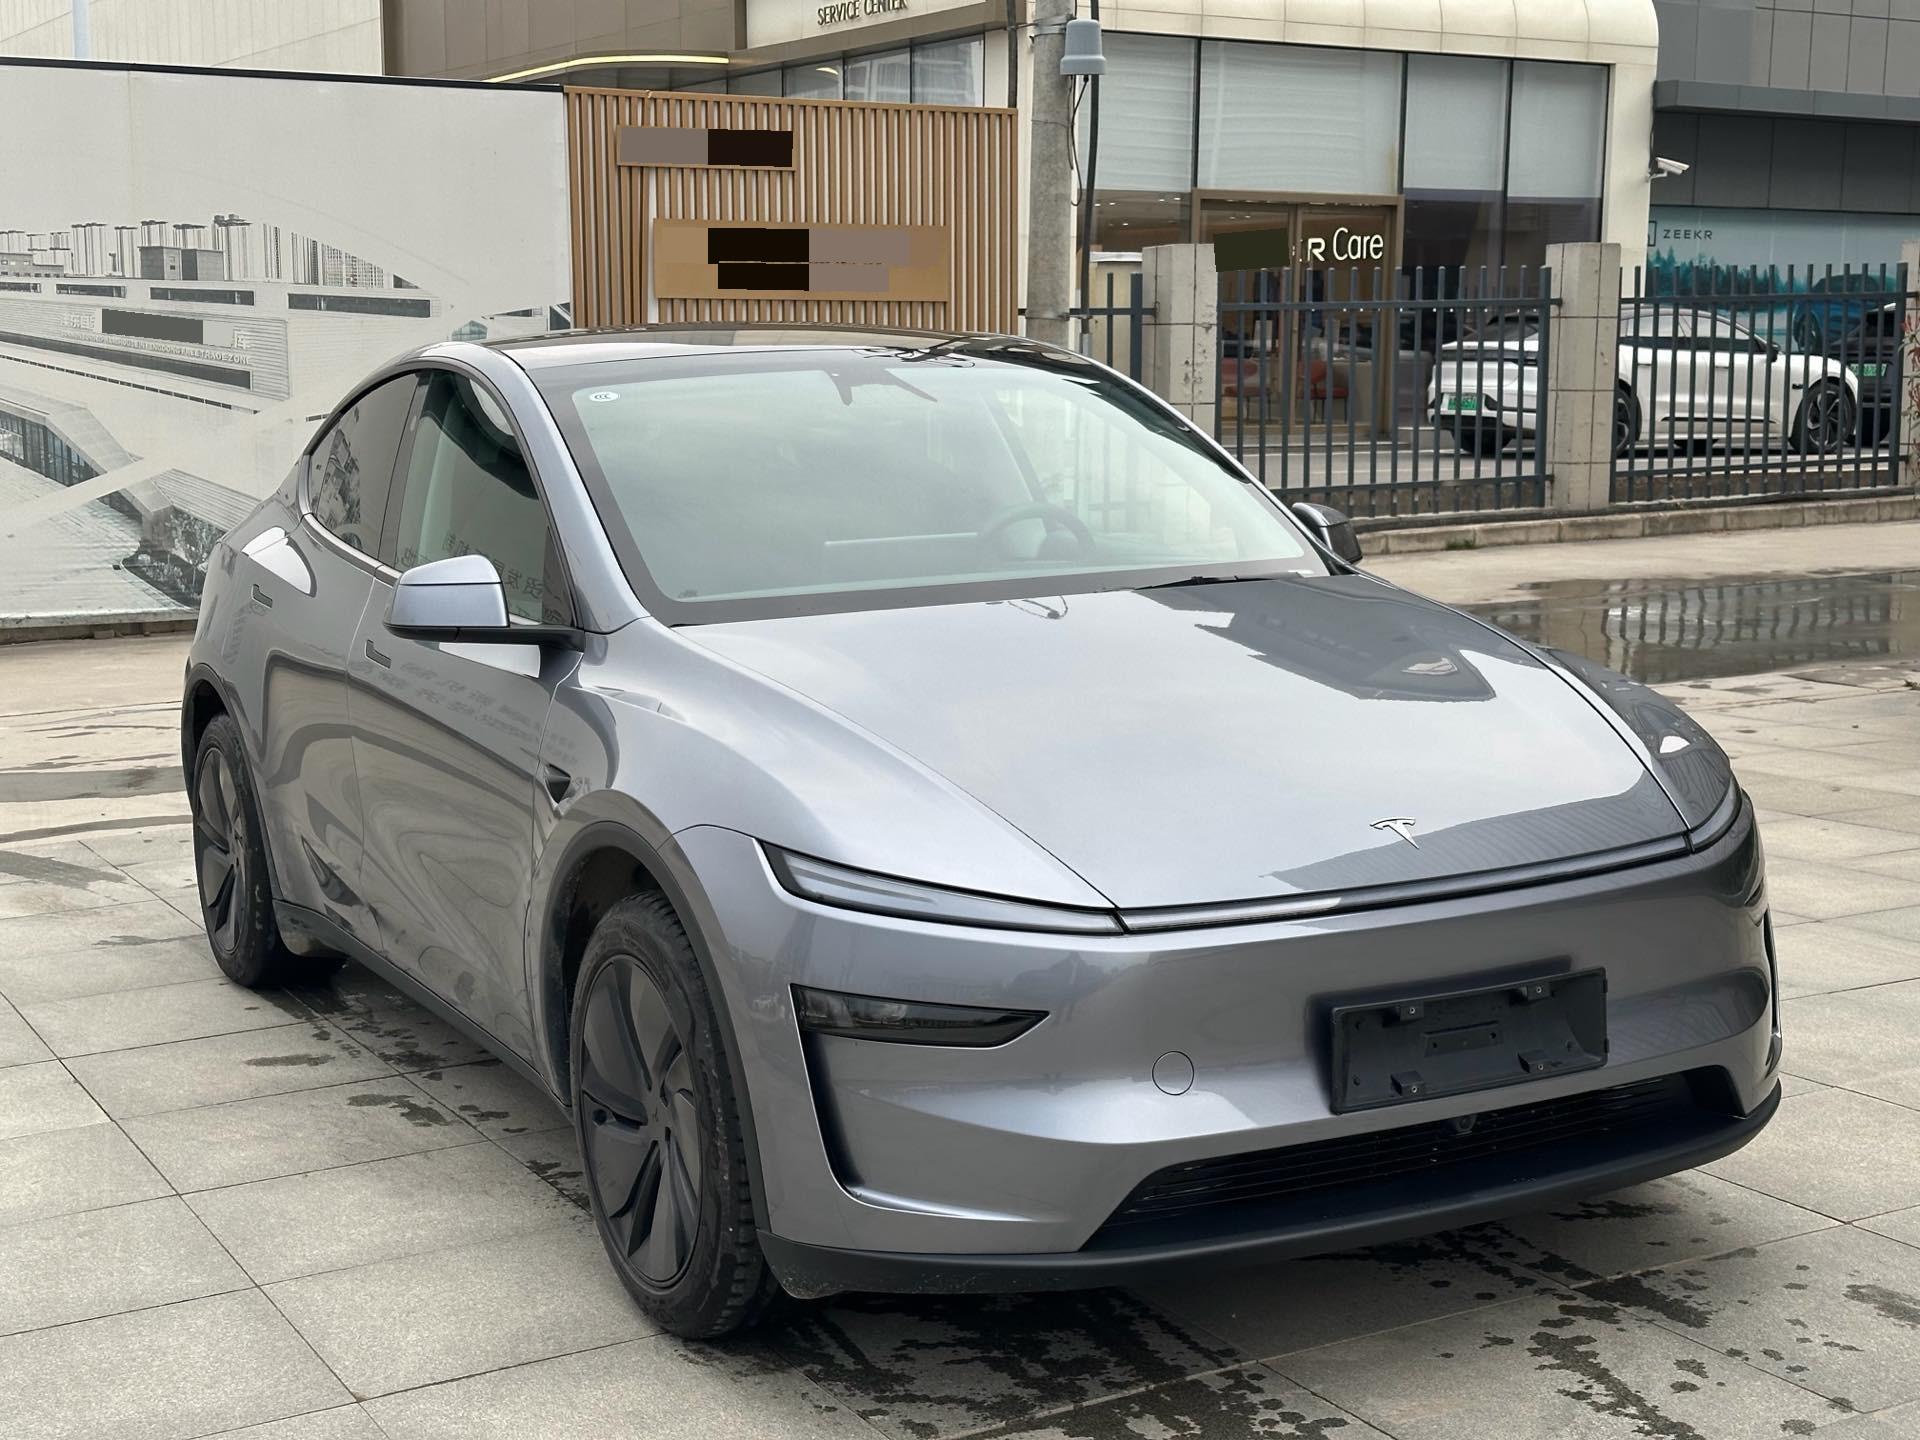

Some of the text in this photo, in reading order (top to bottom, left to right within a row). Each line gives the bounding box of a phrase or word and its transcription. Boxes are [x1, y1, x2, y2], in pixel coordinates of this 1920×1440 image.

[817, 0, 860, 26] SERVICE
[1333, 227, 1384, 261] Care
[1663, 229, 1713, 240] ZEEKR
